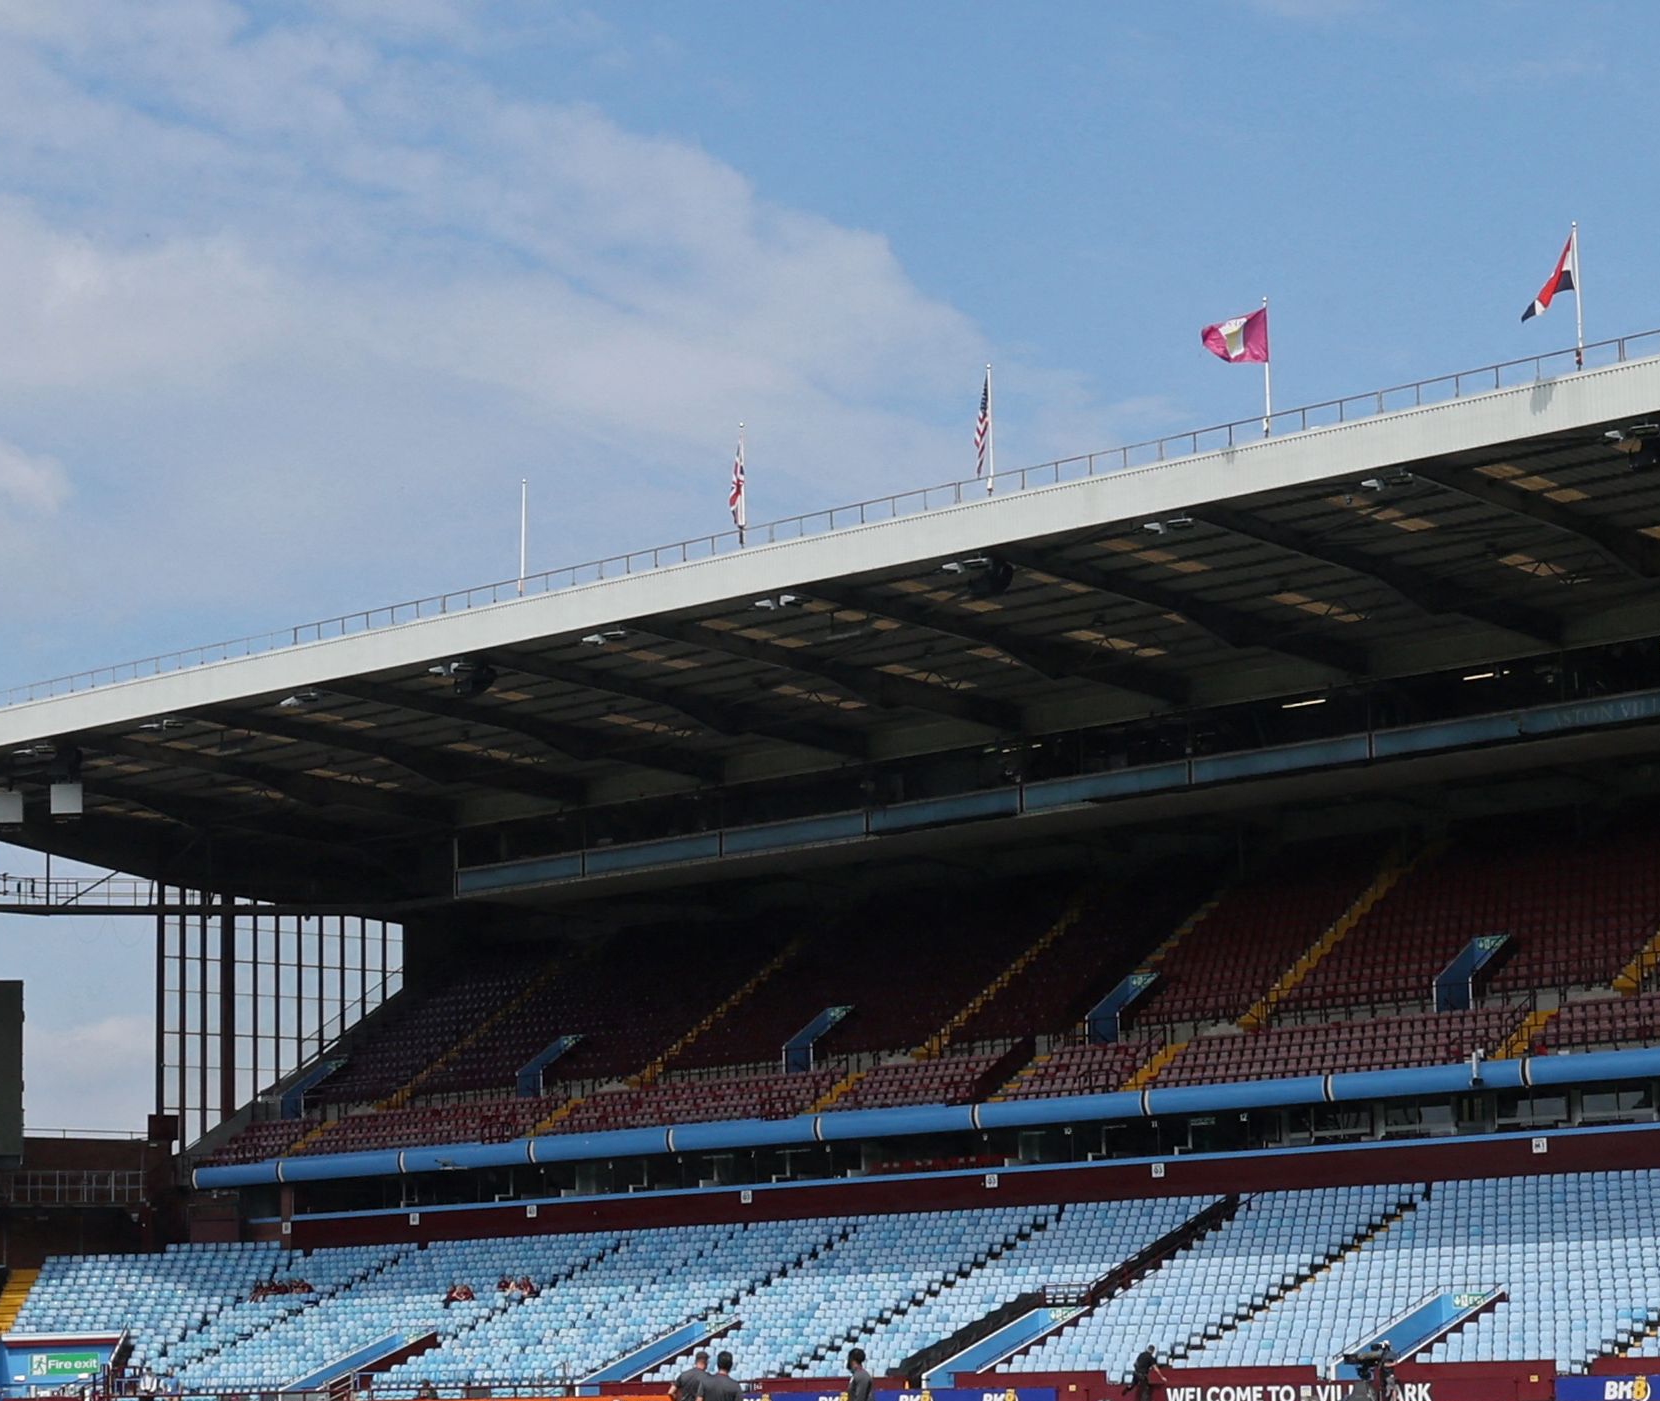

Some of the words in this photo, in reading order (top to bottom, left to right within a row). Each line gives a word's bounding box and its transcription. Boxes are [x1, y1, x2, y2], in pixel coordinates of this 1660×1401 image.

[48, 1359, 72, 1370] Fire
[73, 1358, 97, 1369] exit
[1604, 1379, 1651, 1401] BK8
